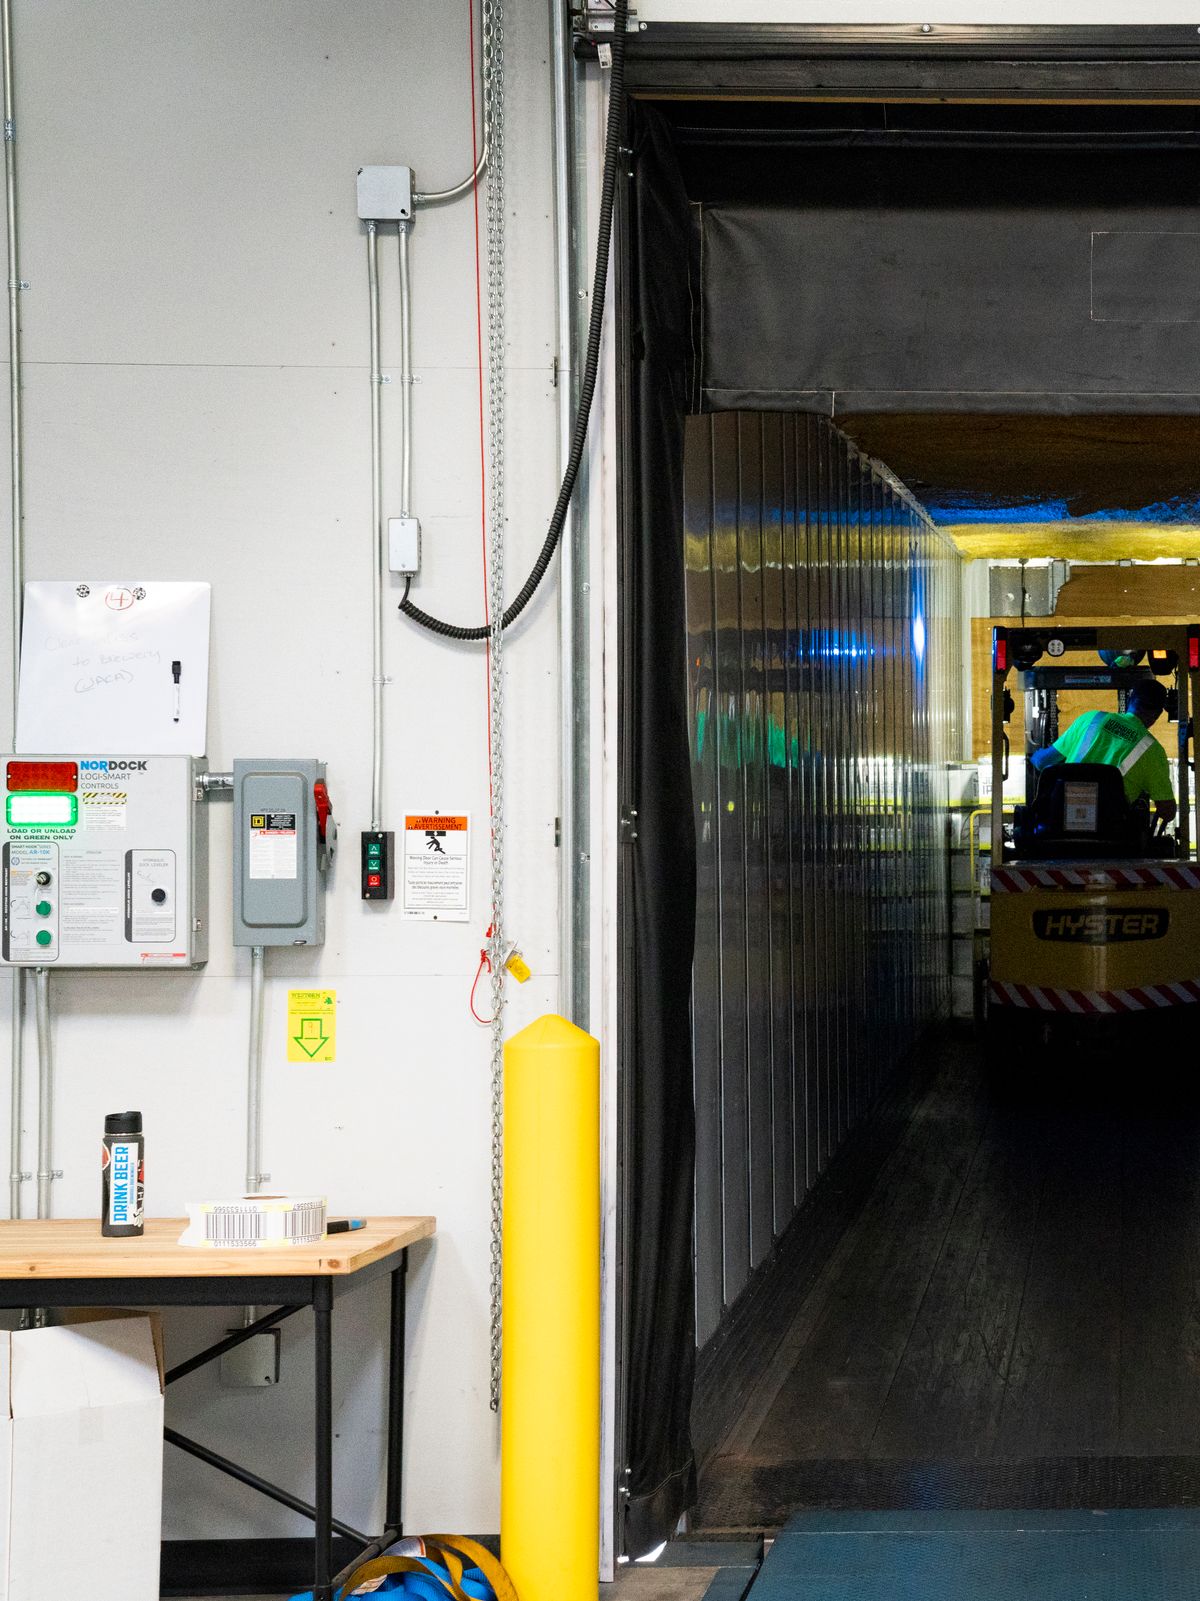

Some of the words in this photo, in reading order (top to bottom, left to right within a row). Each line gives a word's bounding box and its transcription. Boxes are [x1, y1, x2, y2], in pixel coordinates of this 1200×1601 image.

[80, 760, 147, 773] NORDOCK
[80, 773, 131, 781] LOGI-SMART
[1045, 914, 1159, 935] HYSTER
[114, 1146, 129, 1181] BEER
[113, 1183, 128, 1222] DRINK
